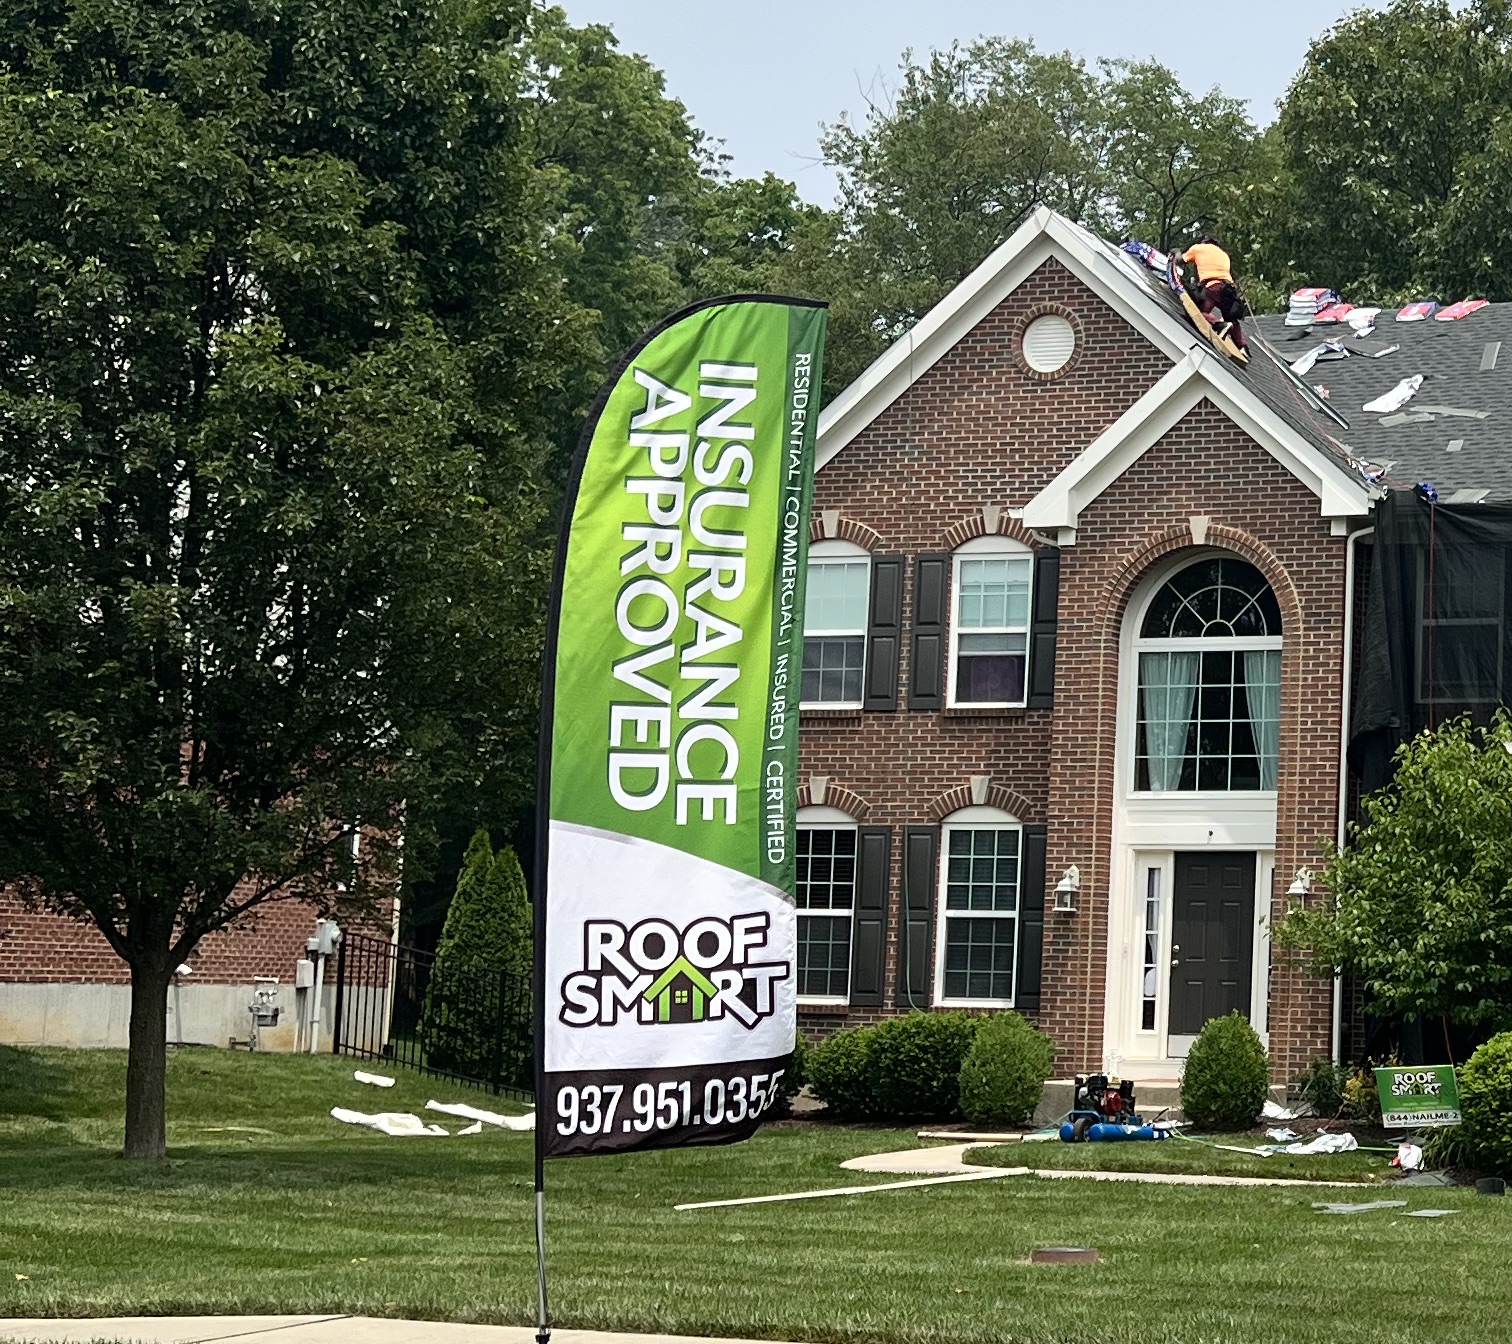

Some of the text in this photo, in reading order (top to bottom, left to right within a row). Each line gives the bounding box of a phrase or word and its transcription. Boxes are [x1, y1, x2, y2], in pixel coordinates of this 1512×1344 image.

[607, 368, 692, 812] APPROVED
[676, 362, 759, 826] INSURANCE
[766, 353, 812, 864] RESIDENTIAL COMMERCIAL INSURED CERTIFIED
[584, 912, 770, 981] ROOF
[561, 962, 789, 1029] SMART
[556, 1069, 785, 1136] 937.951.0355
[1391, 1083, 1442, 1097] SMART
[1393, 1072, 1436, 1087] ROOF
